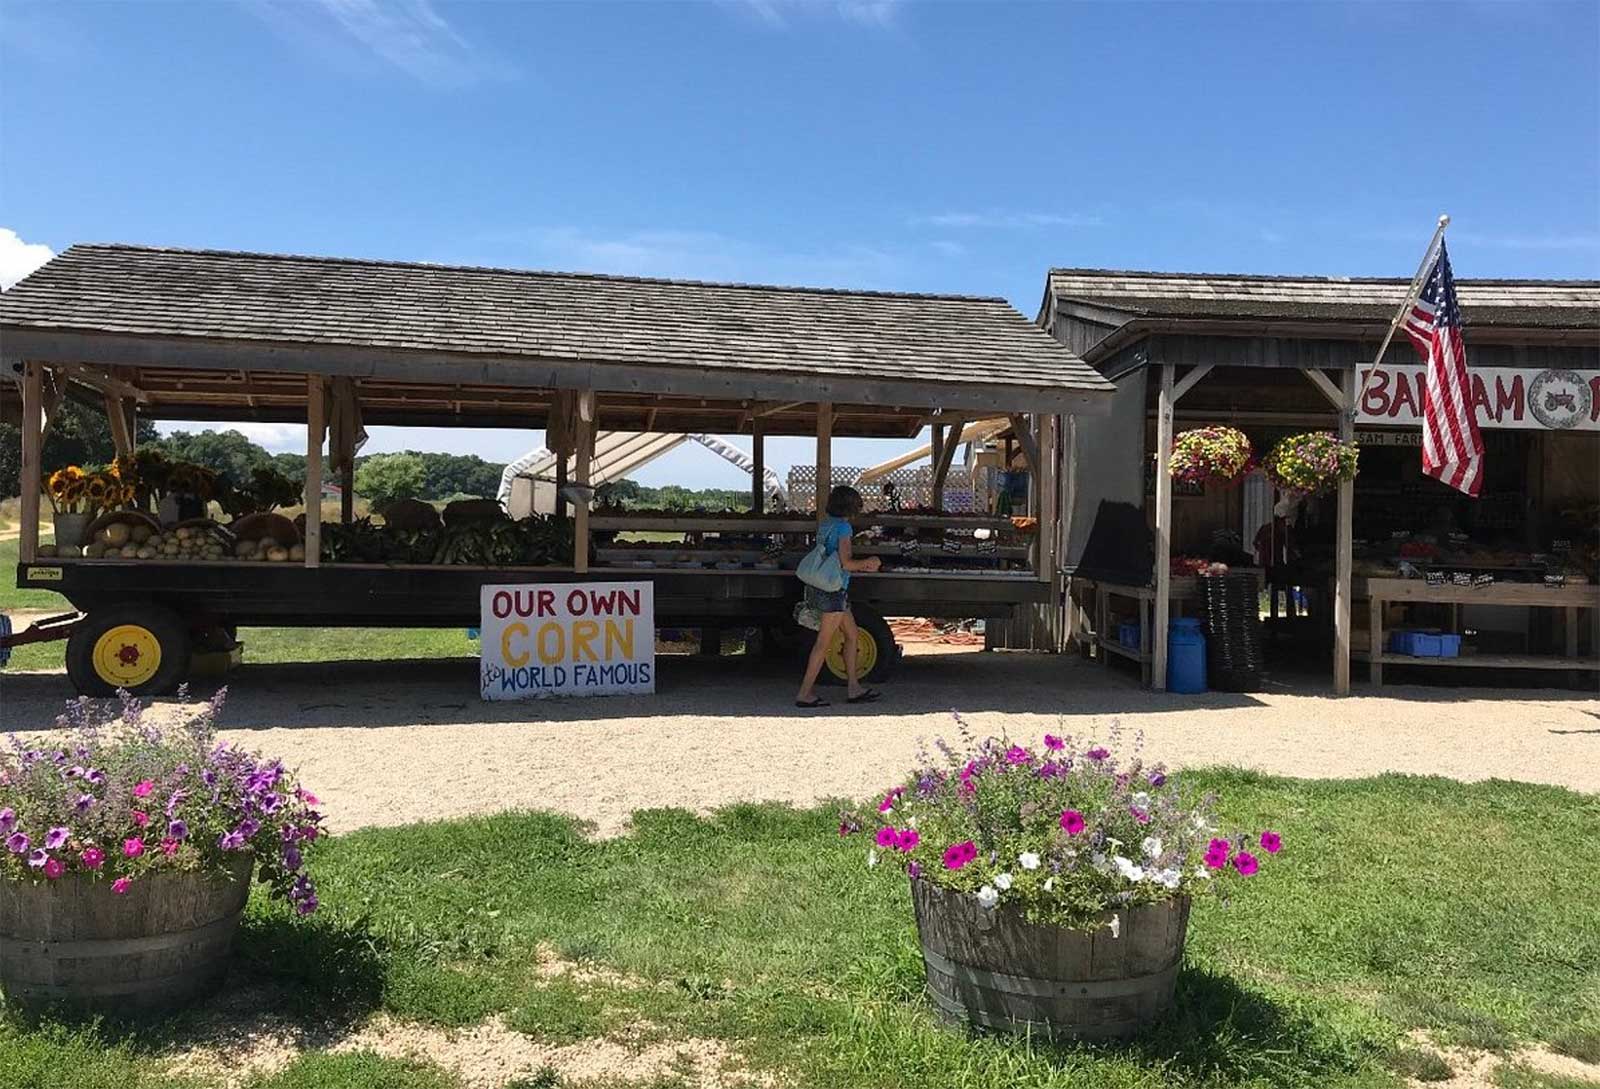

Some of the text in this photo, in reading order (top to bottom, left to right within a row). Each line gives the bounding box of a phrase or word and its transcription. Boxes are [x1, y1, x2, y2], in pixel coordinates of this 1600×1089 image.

[1361, 369, 1525, 423] BAAM
[492, 589, 641, 618] OUR OWN
[501, 618, 634, 667] CORN
[502, 666, 566, 692] WORLD
[573, 662, 651, 686] FAMOUS
